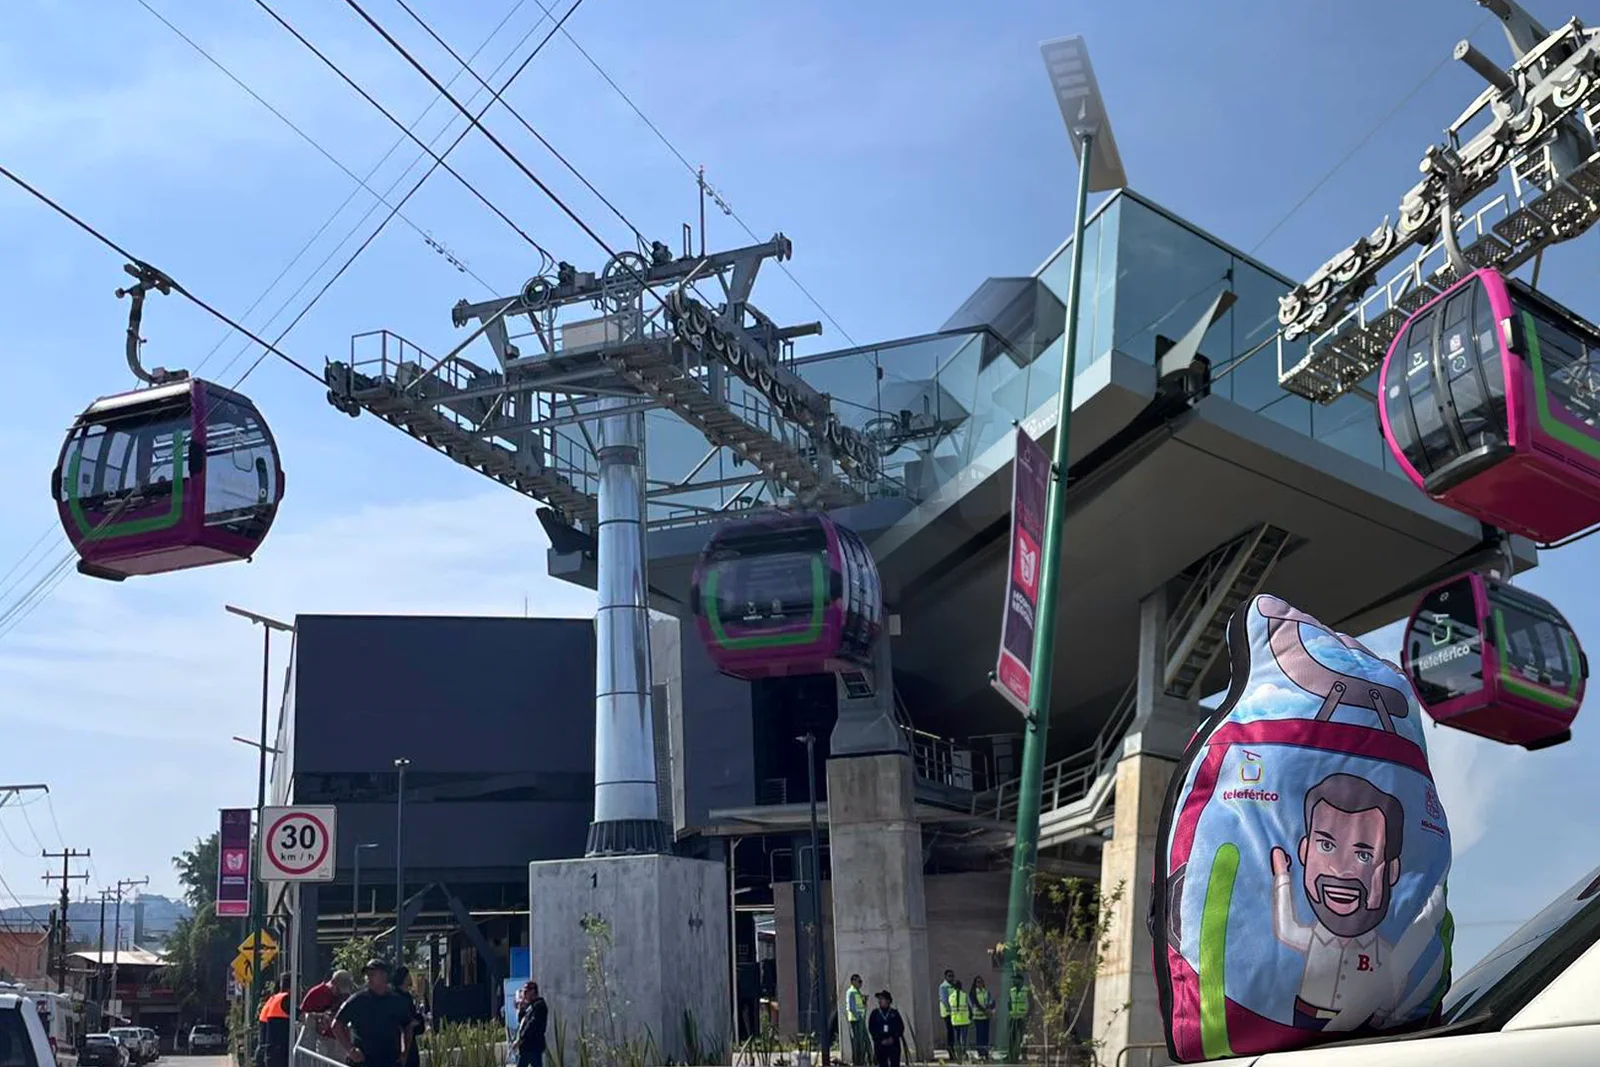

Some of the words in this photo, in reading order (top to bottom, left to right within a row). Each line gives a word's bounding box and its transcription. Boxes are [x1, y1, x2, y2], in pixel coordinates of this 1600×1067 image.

[1418, 643, 1470, 671] teleférico
[1223, 789, 1279, 802] teleférico
[281, 825, 316, 849] 30
[590, 872, 597, 888] 1
[1357, 954, 1374, 972] B.
